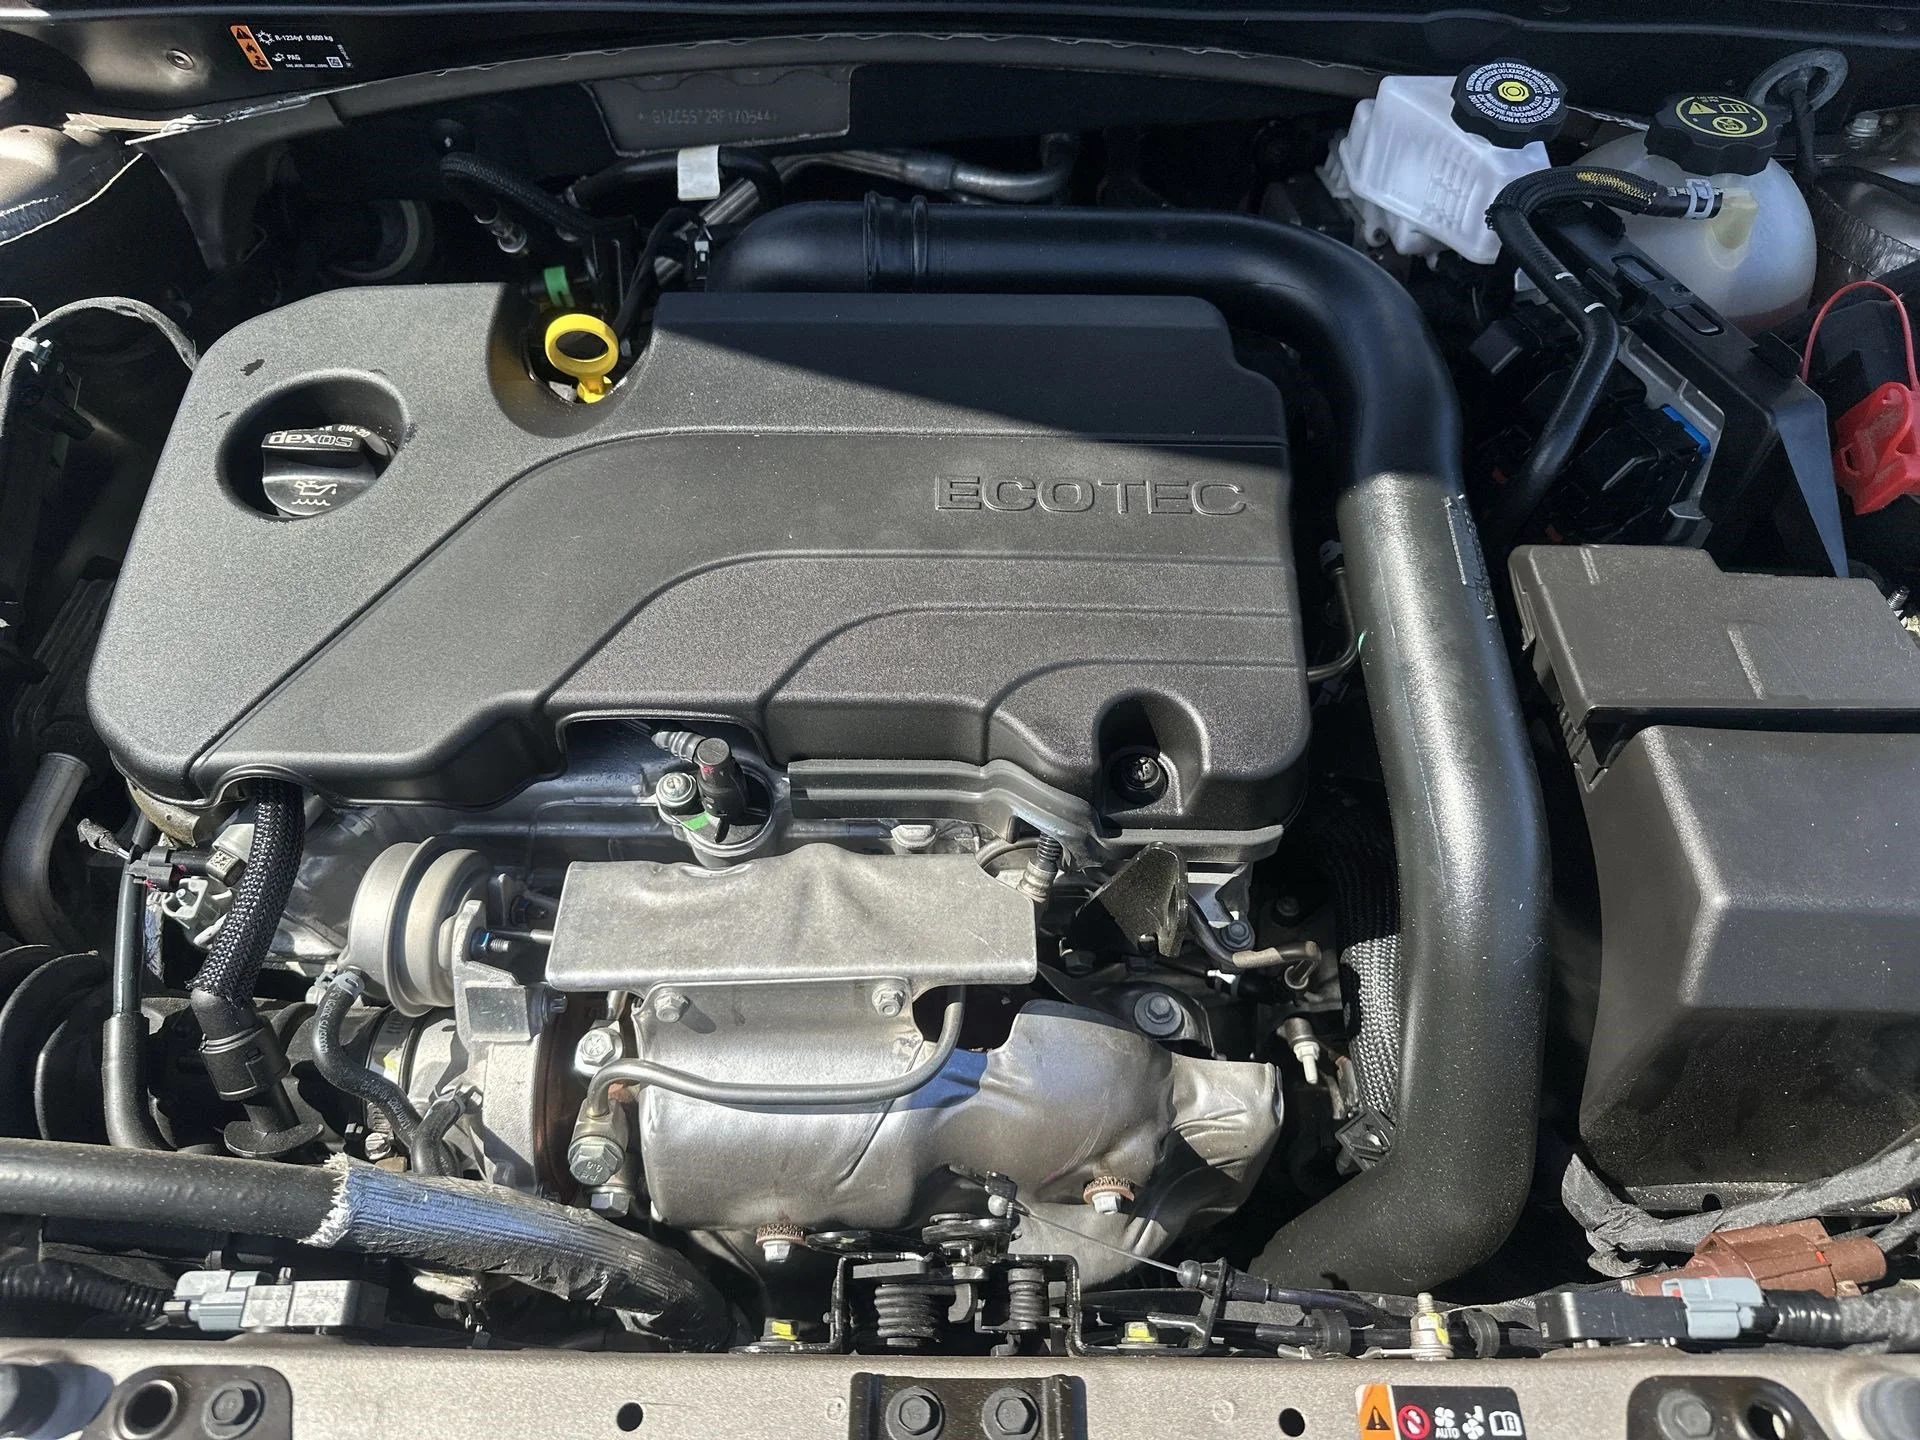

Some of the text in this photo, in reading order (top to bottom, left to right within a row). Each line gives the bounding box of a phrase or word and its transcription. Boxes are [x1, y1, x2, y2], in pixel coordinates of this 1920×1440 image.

[1494, 113, 1514, 123] FROM
[1519, 115, 1543, 124] SEALED
[338, 424, 371, 438] 0W-20
[268, 431, 354, 448] dexos
[934, 475, 1247, 516] ECOTEC
[1435, 1427, 1461, 1440] AUTO
